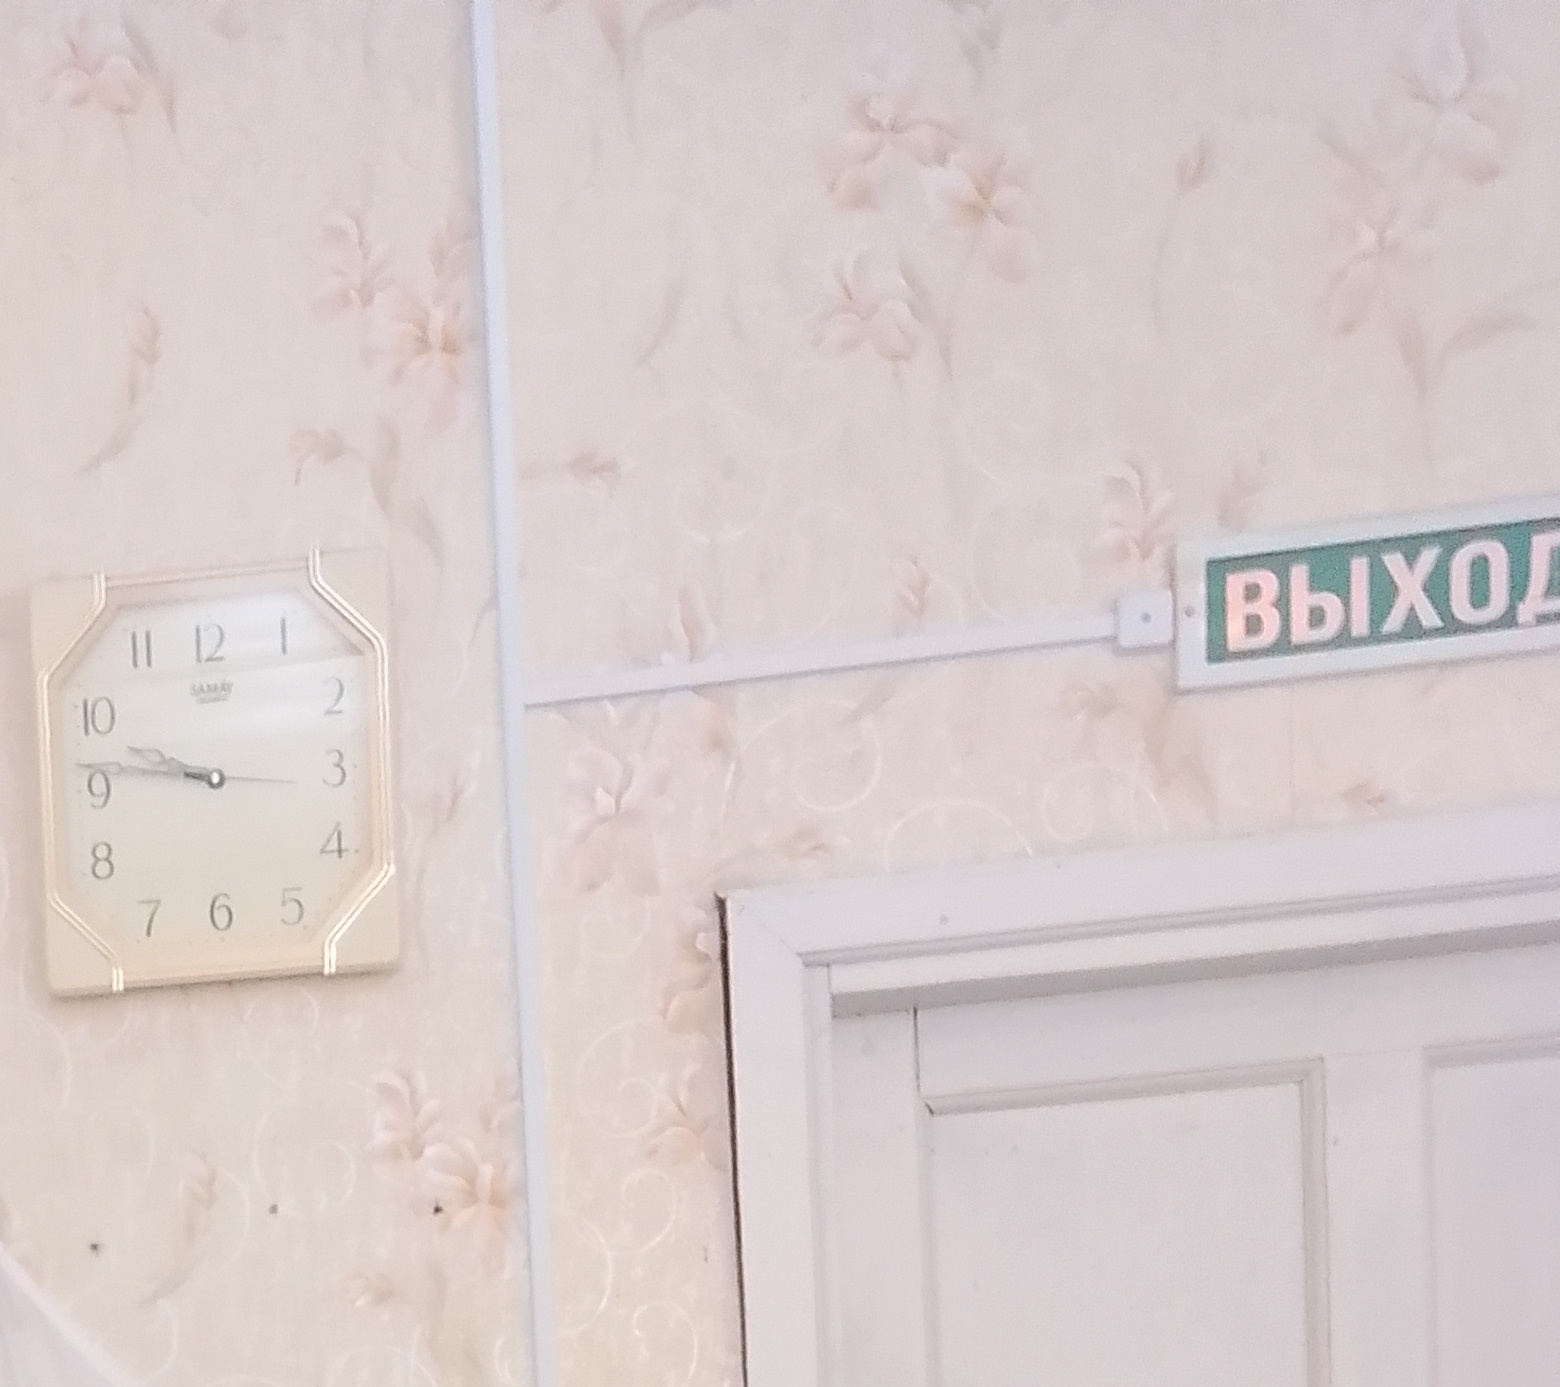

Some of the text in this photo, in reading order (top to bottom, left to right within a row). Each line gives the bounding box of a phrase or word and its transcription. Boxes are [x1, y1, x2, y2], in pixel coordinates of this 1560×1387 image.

[1225, 531, 1560, 653] ВЫХОД
[130, 629, 152, 669] 11
[194, 623, 225, 663] 12
[81, 696, 116, 736] 10
[323, 676, 345, 716] 2
[321, 749, 347, 787] 3
[86, 770, 112, 809] 9
[90, 841, 115, 880] 8
[319, 822, 349, 859] 4
[139, 898, 162, 938] 7
[208, 892, 234, 932] 6
[280, 887, 305, 926] 5
